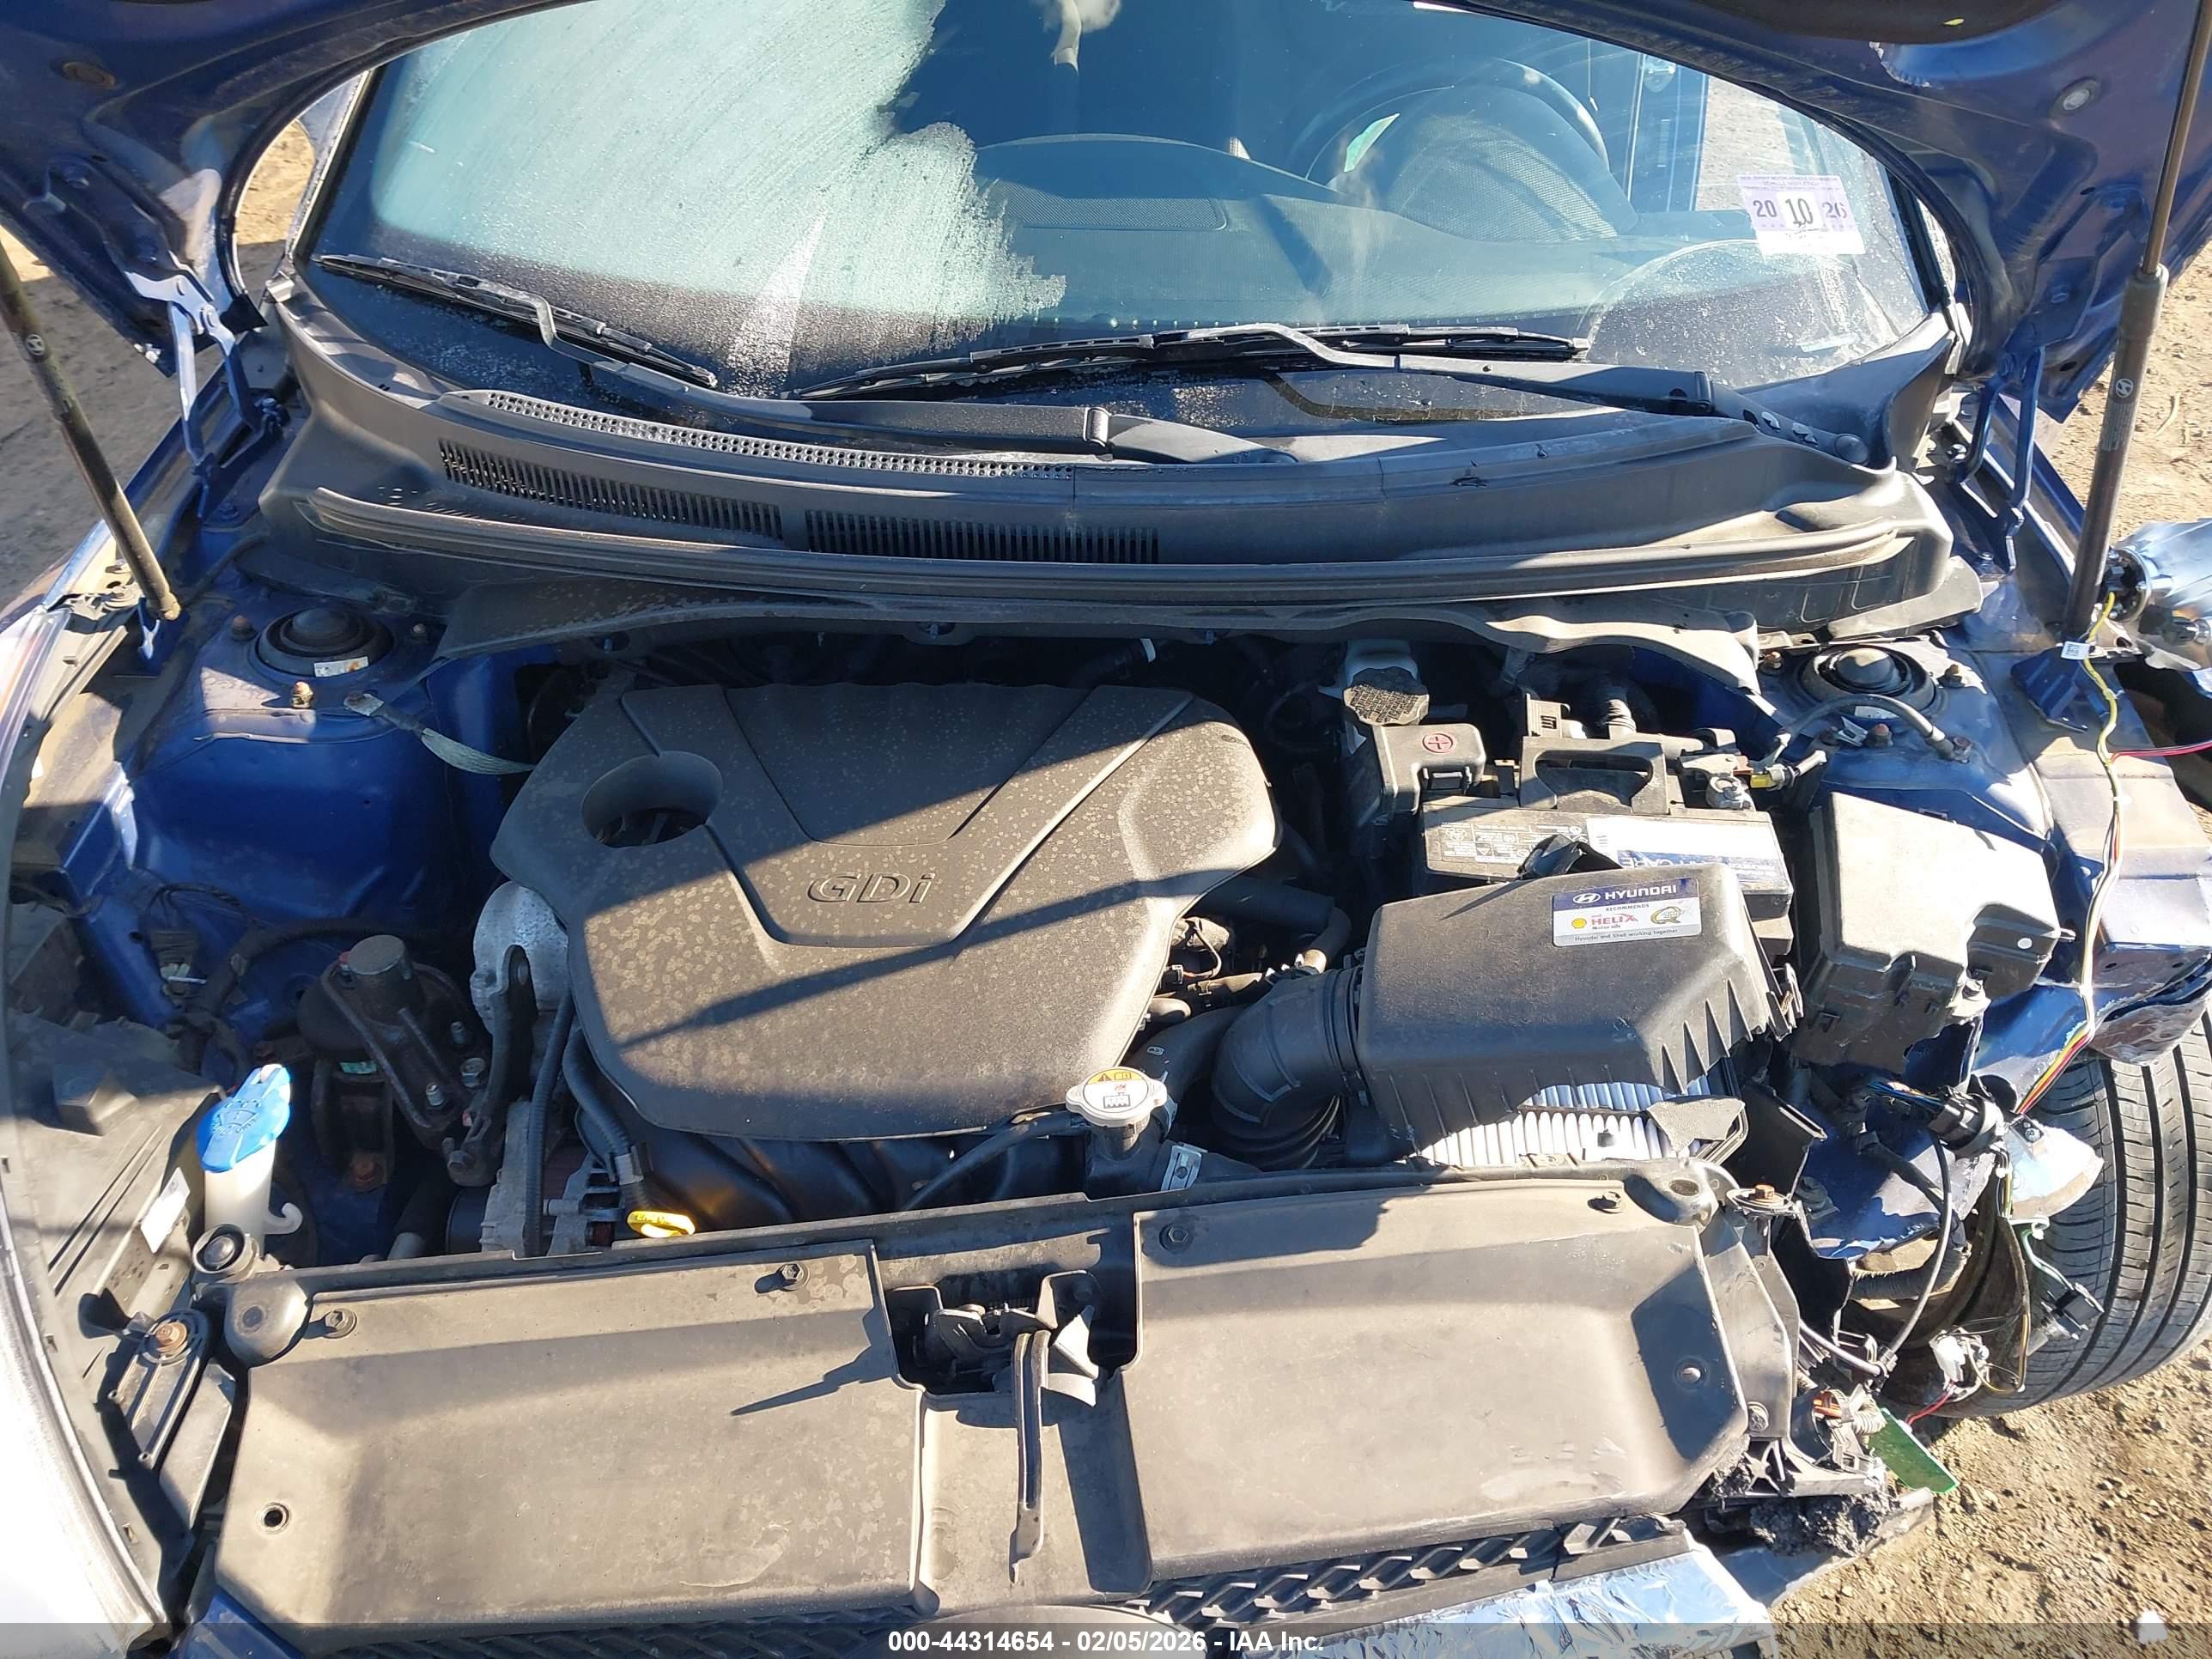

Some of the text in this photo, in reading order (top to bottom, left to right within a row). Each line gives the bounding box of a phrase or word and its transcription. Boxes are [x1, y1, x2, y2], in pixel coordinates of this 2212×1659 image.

[1753, 198, 1847, 225] 20 10 26
[807, 872, 936, 903] GDi
[1605, 885, 1677, 901] HYUNDAI
[1606, 903, 1650, 912] RECOMMENDS
[1591, 914, 1638, 926] HELIX
